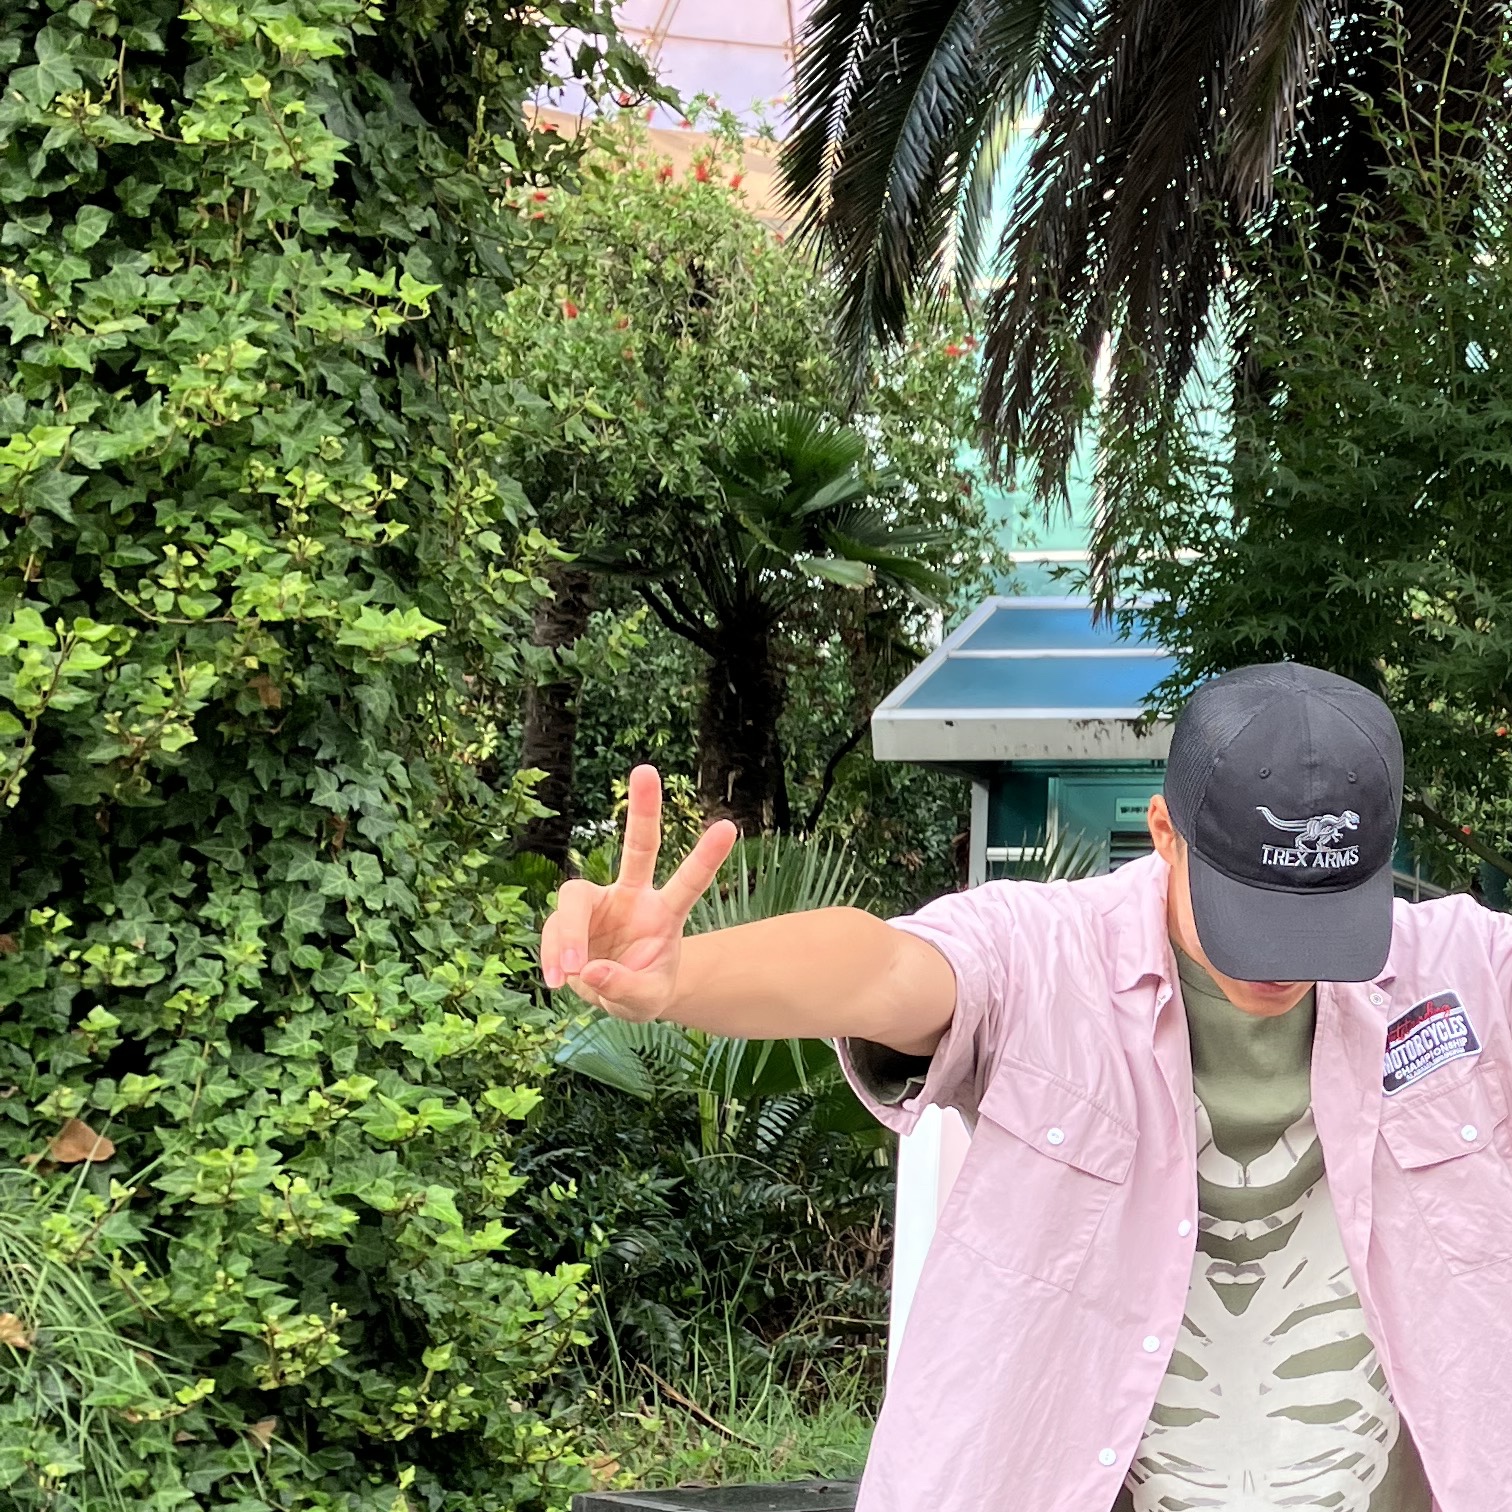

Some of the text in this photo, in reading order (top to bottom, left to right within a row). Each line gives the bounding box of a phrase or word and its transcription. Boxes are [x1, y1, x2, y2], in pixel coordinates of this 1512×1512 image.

[1262, 846, 1360, 868] T.REX ARMS
[1383, 1015, 1468, 1077] MOTORCYCLES
[1394, 1037, 1467, 1080] CHAMPIONSHIP
